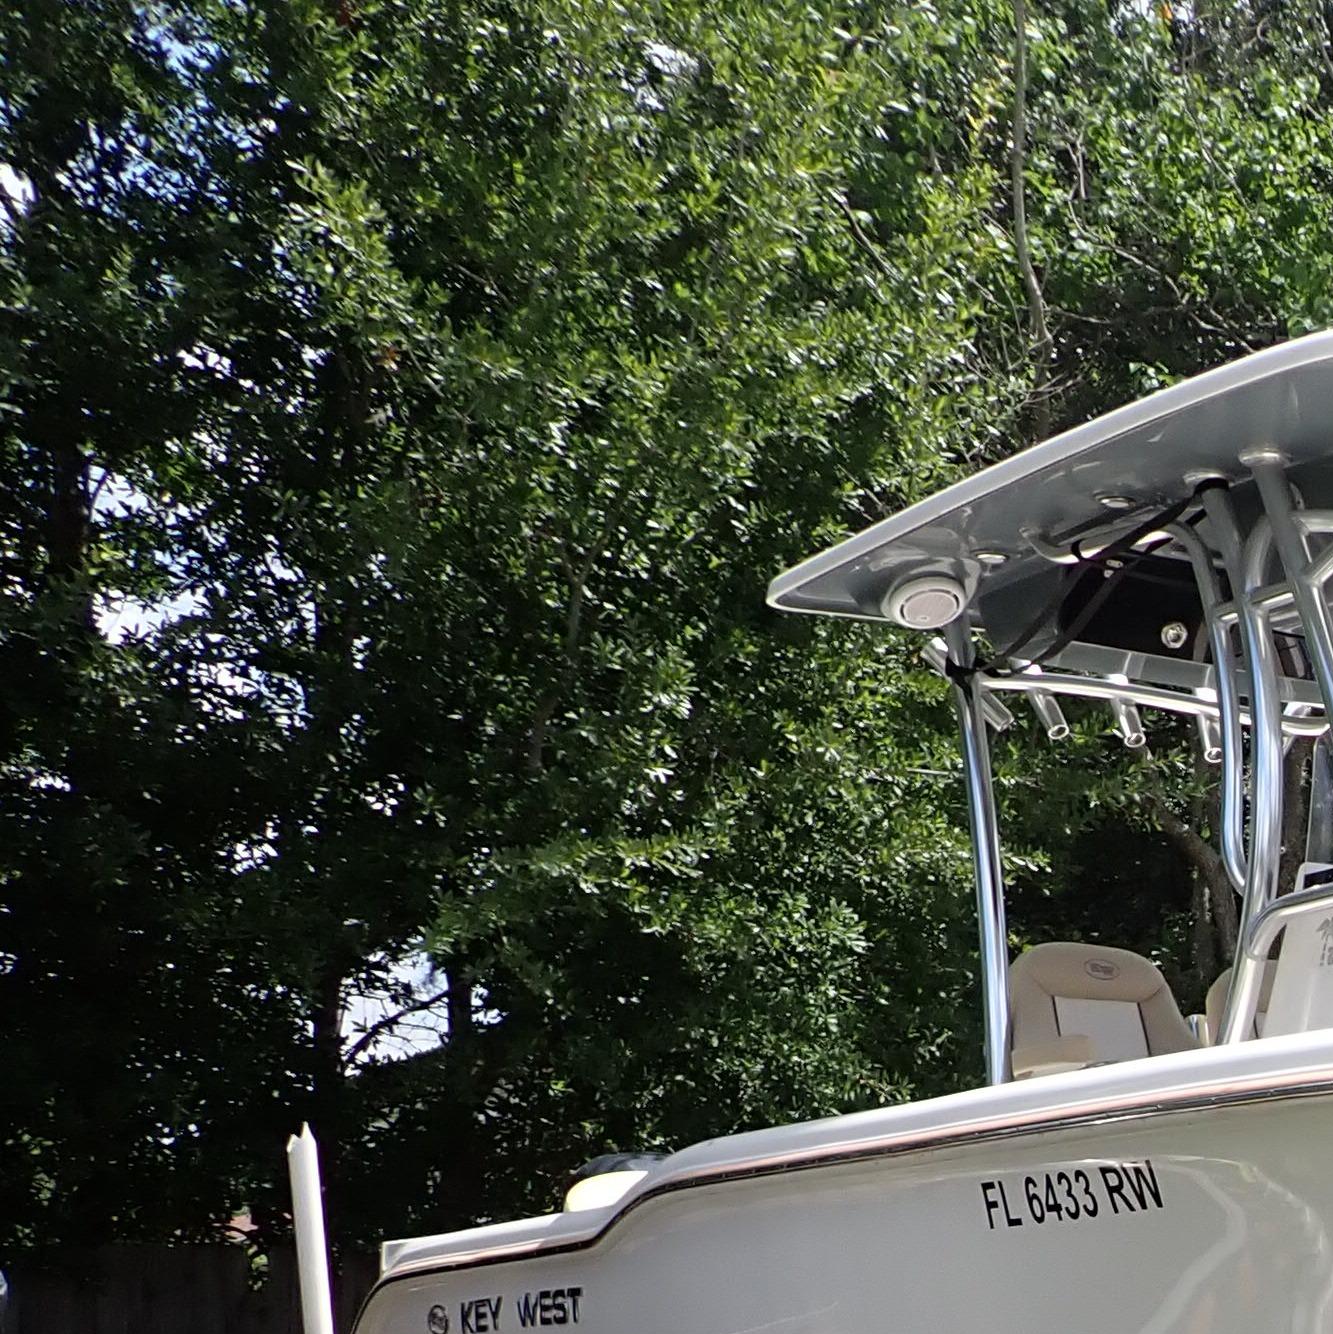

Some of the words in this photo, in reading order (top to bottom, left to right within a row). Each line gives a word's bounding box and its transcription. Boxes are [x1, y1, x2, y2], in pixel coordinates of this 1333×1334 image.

[980, 1180, 1022, 1229] FL
[1024, 1169, 1098, 1224] 6433
[1099, 1160, 1164, 1214] RW
[460, 1296, 502, 1334] KEY
[517, 1287, 583, 1328] WEST
